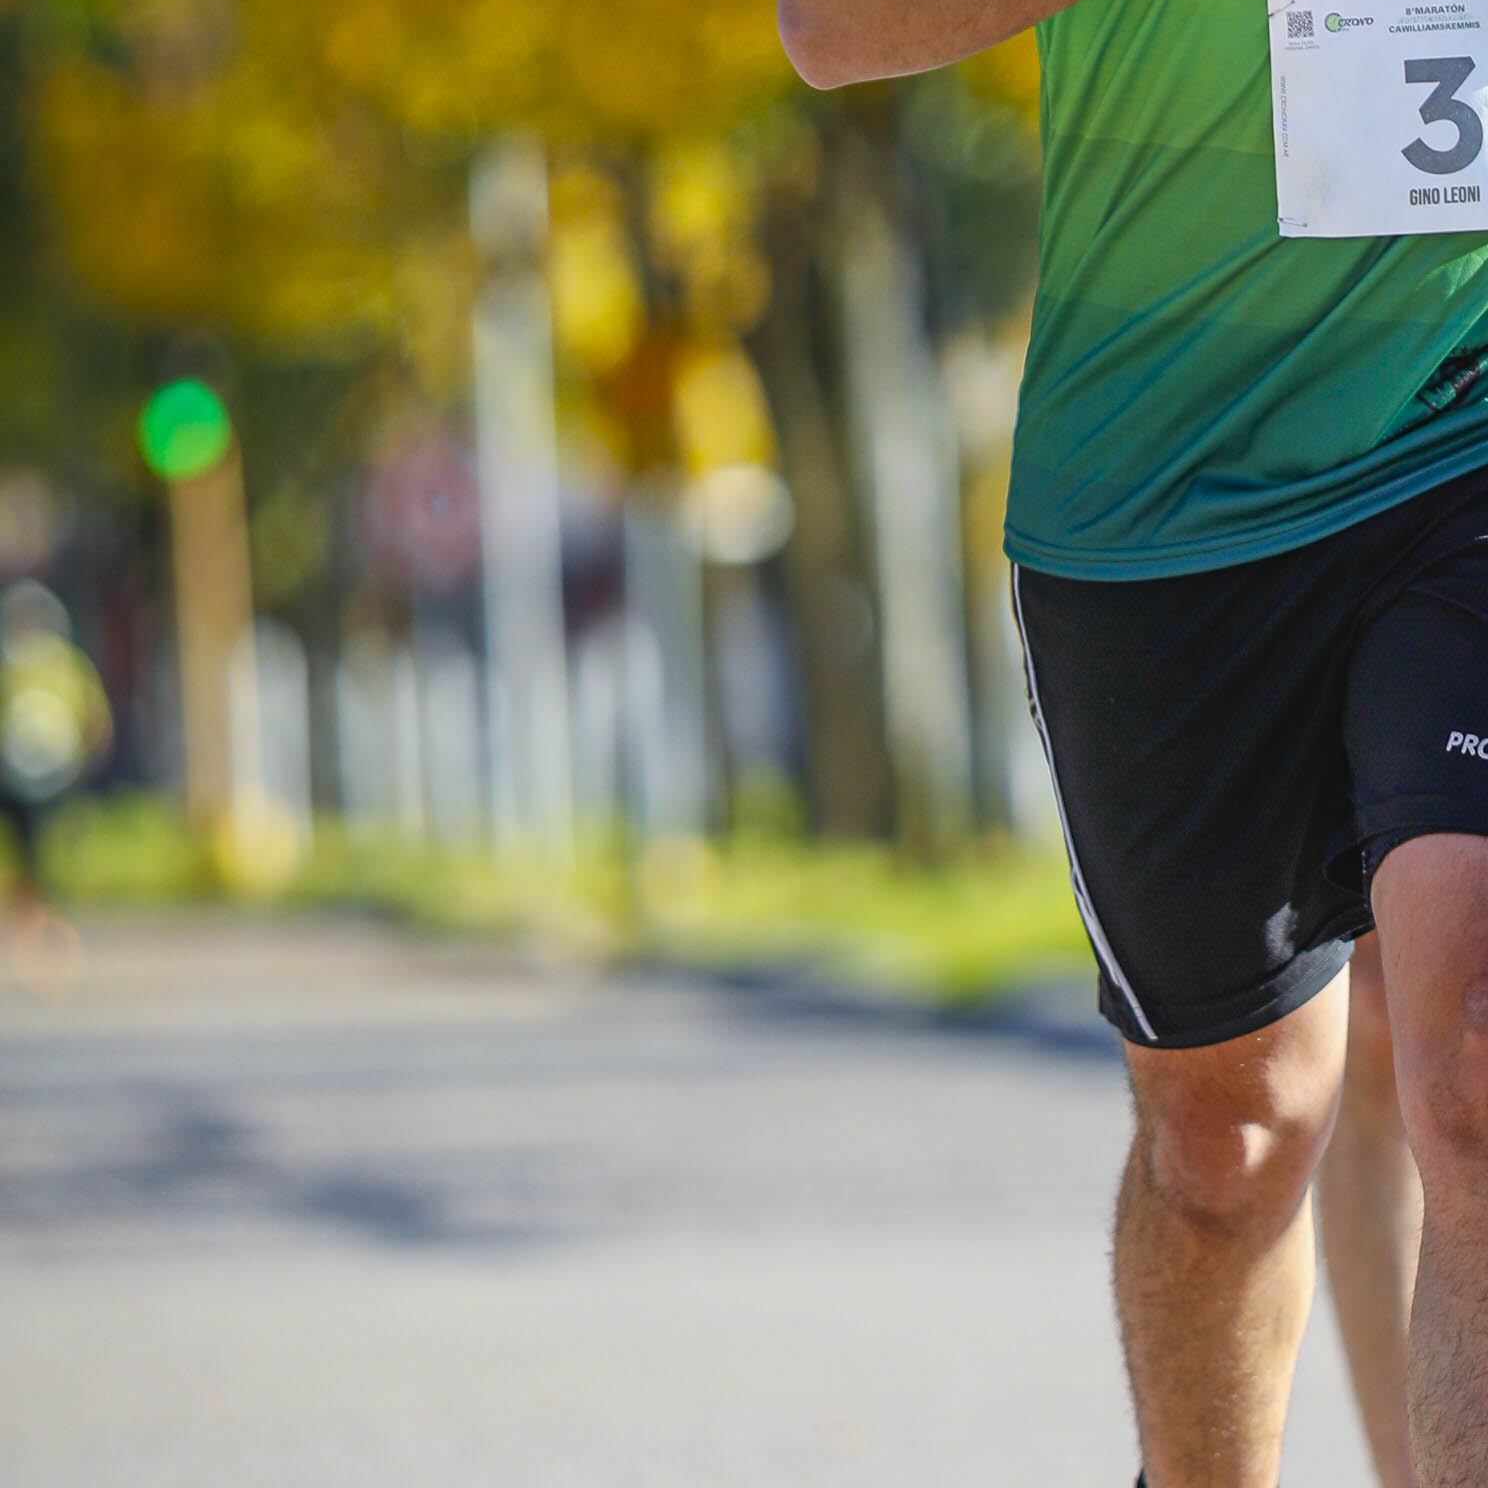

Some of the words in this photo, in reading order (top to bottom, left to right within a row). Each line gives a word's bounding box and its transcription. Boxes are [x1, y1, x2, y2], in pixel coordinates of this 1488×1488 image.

[1388, 21, 1480, 33] CAWILLIAMSKEMMIS
[1401, 55, 1484, 175] 3
[1409, 187, 1441, 206] GINO
[1443, 185, 1481, 204] LEONI
